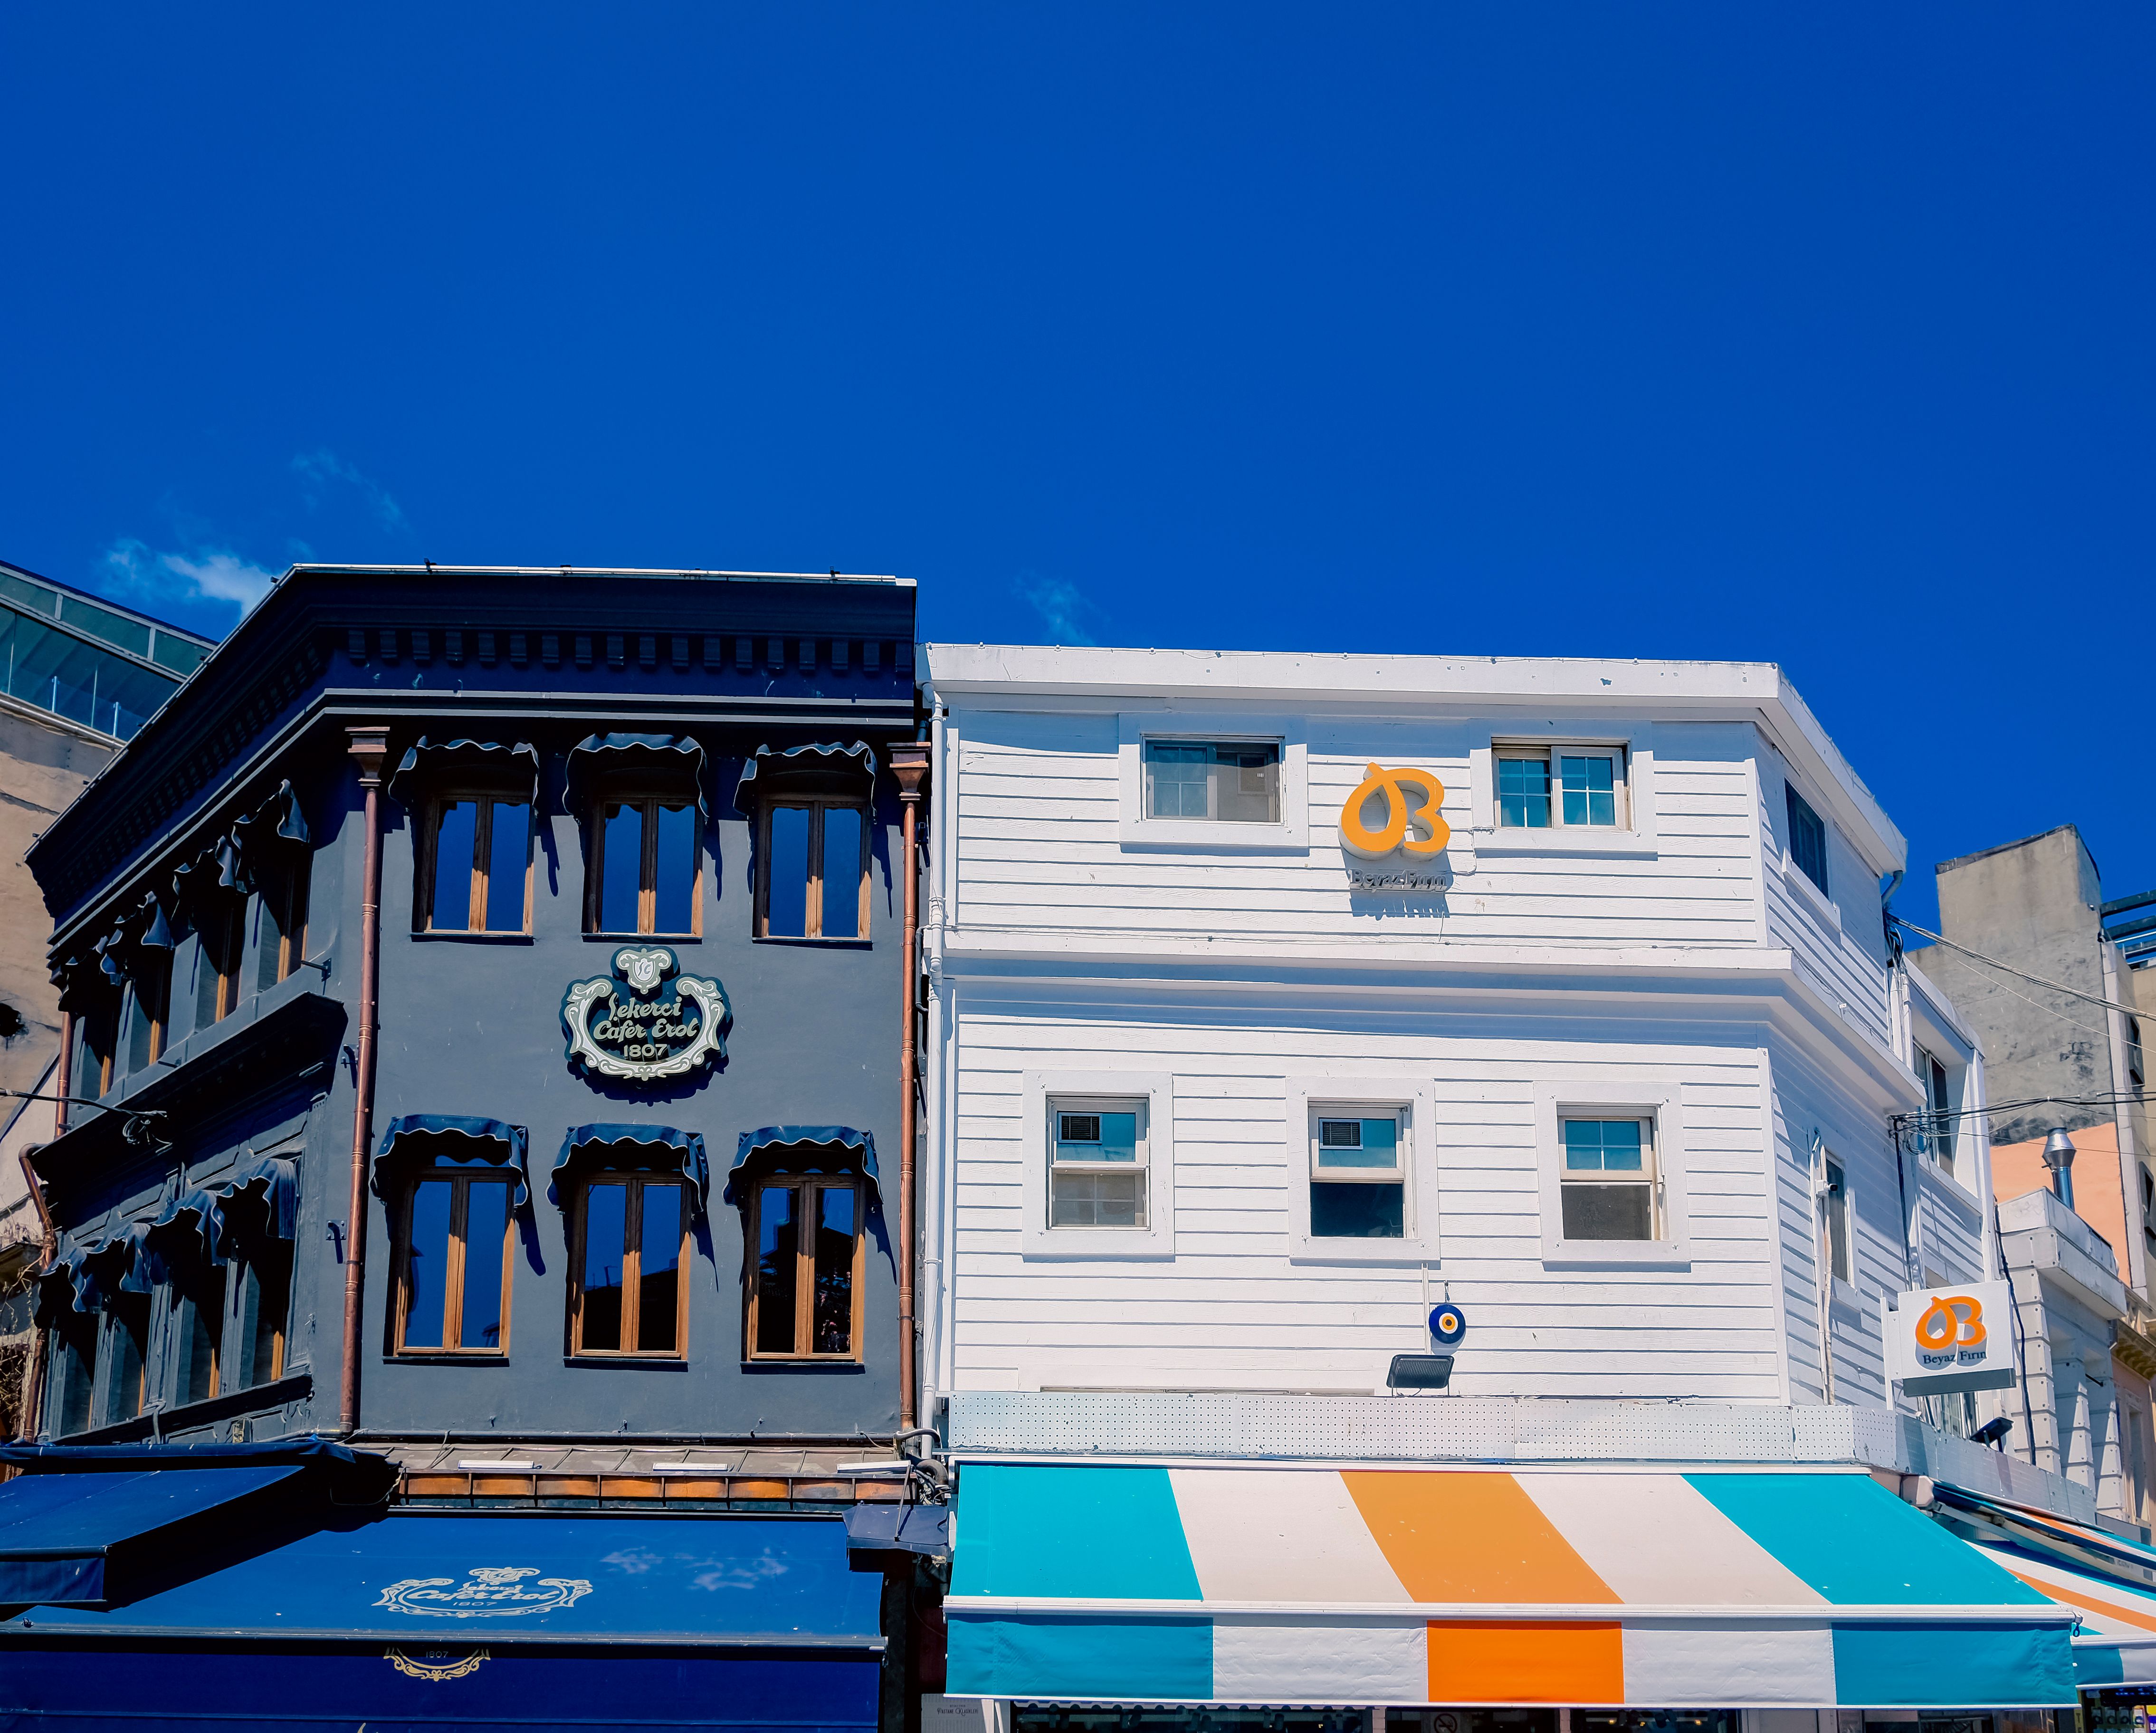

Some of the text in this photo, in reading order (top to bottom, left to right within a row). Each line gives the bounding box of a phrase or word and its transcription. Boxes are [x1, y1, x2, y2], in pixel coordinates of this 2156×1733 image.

[1349, 869, 1403, 892] Beyaz
[609, 992, 682, 1022] Şekerci
[593, 1017, 700, 1043] Cafer Erol
[623, 1044, 668, 1059] 1807
[1922, 1350, 1987, 1365] Beyaz Fırın
[406, 1589, 560, 1601] Cafer Erol
